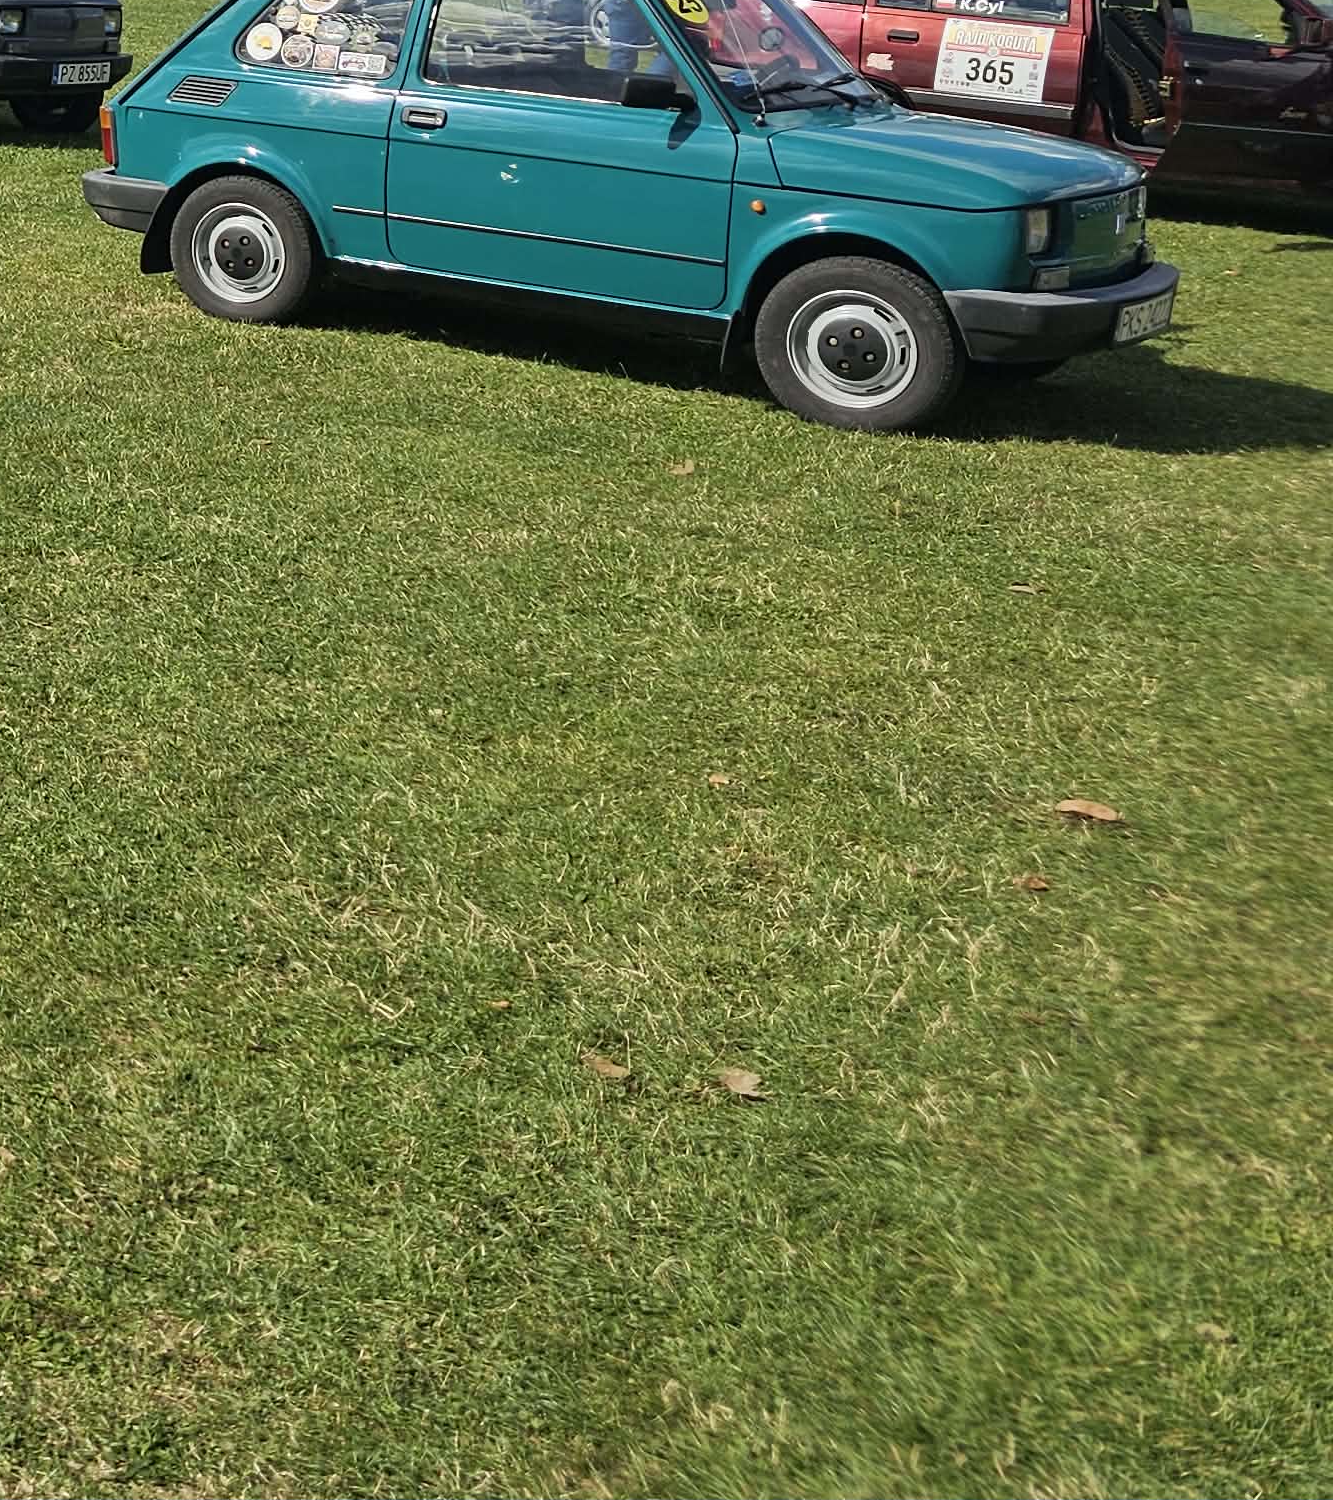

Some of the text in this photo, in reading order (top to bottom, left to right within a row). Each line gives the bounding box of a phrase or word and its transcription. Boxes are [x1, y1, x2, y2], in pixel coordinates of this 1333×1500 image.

[955, 29, 1037, 53] RAJD KOGUTA
[60, 65, 76, 83] PZ
[965, 57, 1015, 86] 365
